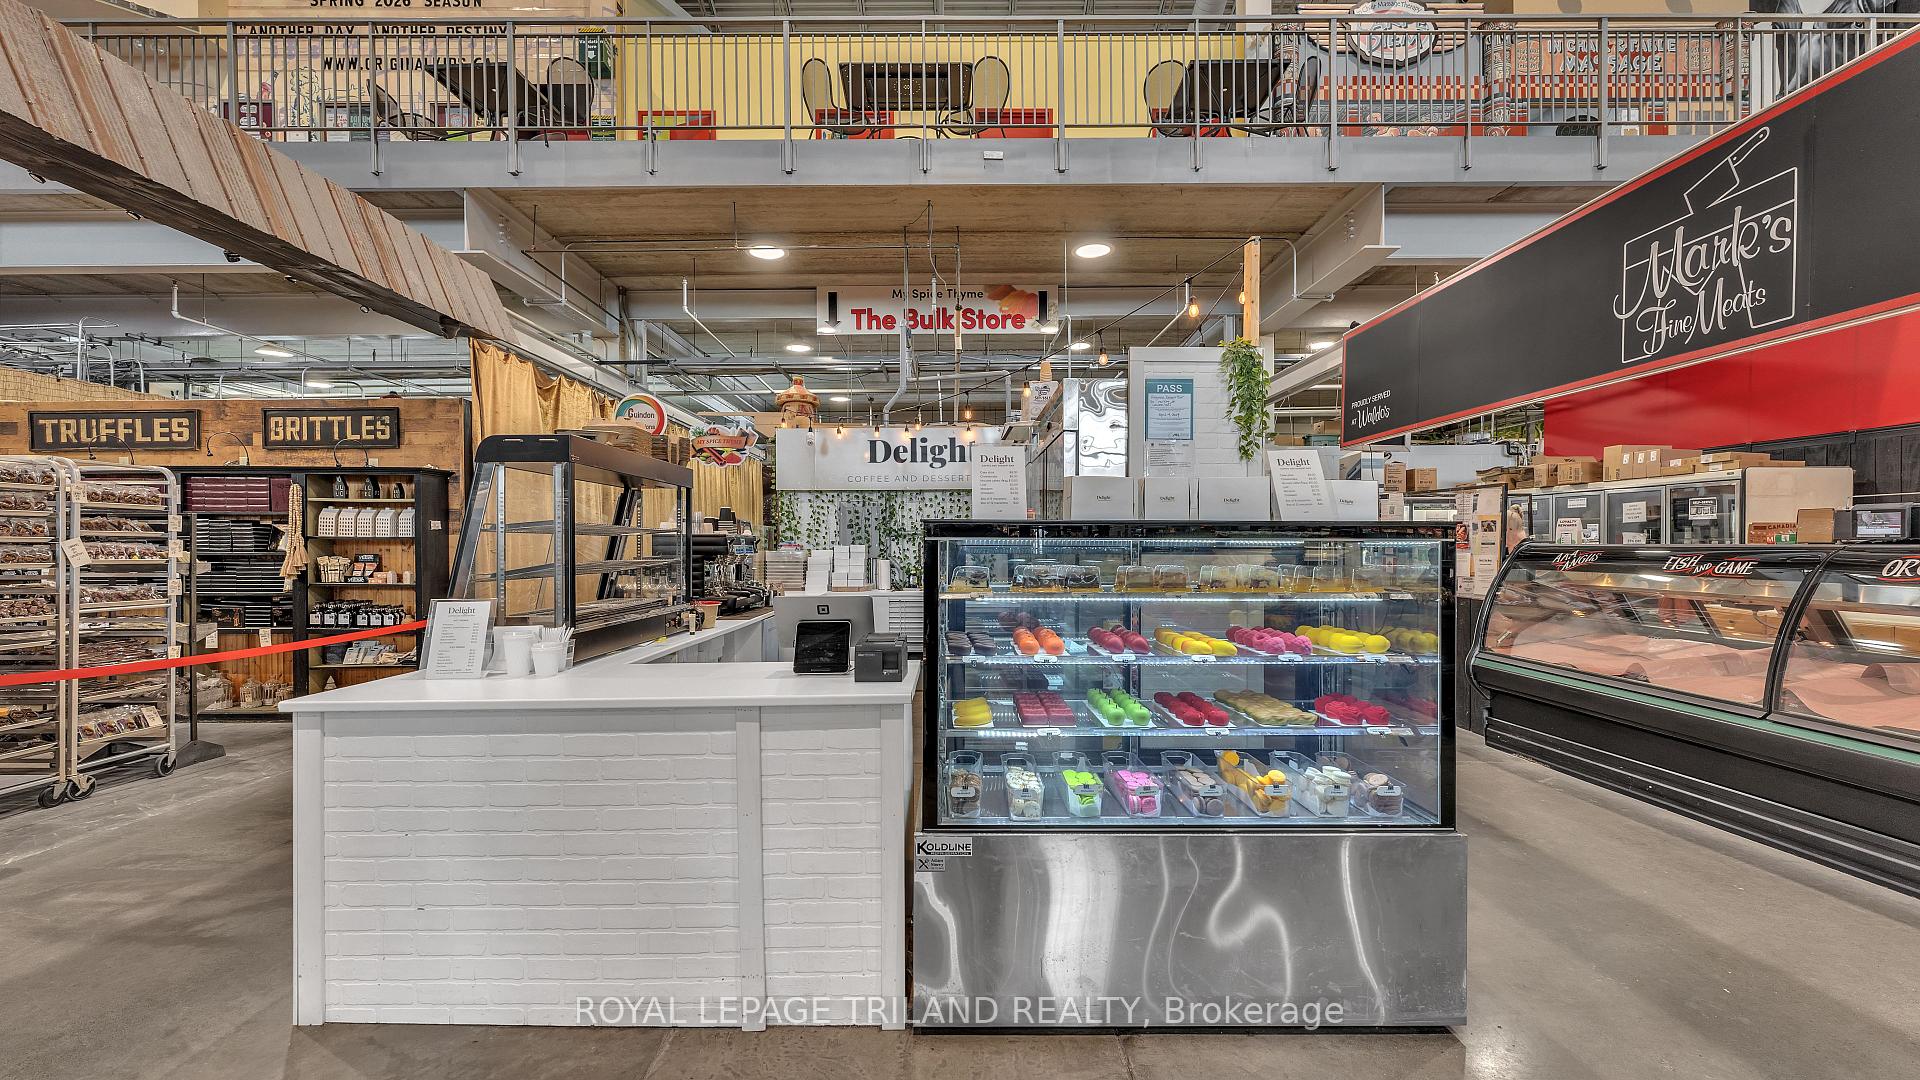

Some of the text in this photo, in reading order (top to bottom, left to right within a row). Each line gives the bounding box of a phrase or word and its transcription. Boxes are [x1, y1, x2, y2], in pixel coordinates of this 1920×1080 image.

[1568, 39, 1611, 54] CHA
[1613, 206, 1793, 319] Mark's
[947, 288, 984, 301] Thyme
[850, 307, 1026, 331] The Bulk Store
[1636, 278, 1766, 355] Fine Meats
[1156, 384, 1183, 393] PASS
[1351, 389, 1391, 410] PROUDLY SERVED
[38, 417, 191, 443] TRUFFLES
[269, 415, 391, 441] BRITTLES
[979, 454, 1015, 465] Delight
[1276, 458, 1311, 467] Delight
[847, 474, 971, 483] COFFEE AND DESSERT
[1561, 553, 1599, 571] ANGUS
[1662, 554, 1759, 575] FISH AND GAME
[1881, 559, 1920, 577] OR
[448, 606, 476, 615] Delight
[916, 839, 972, 856] KOLDLINE
